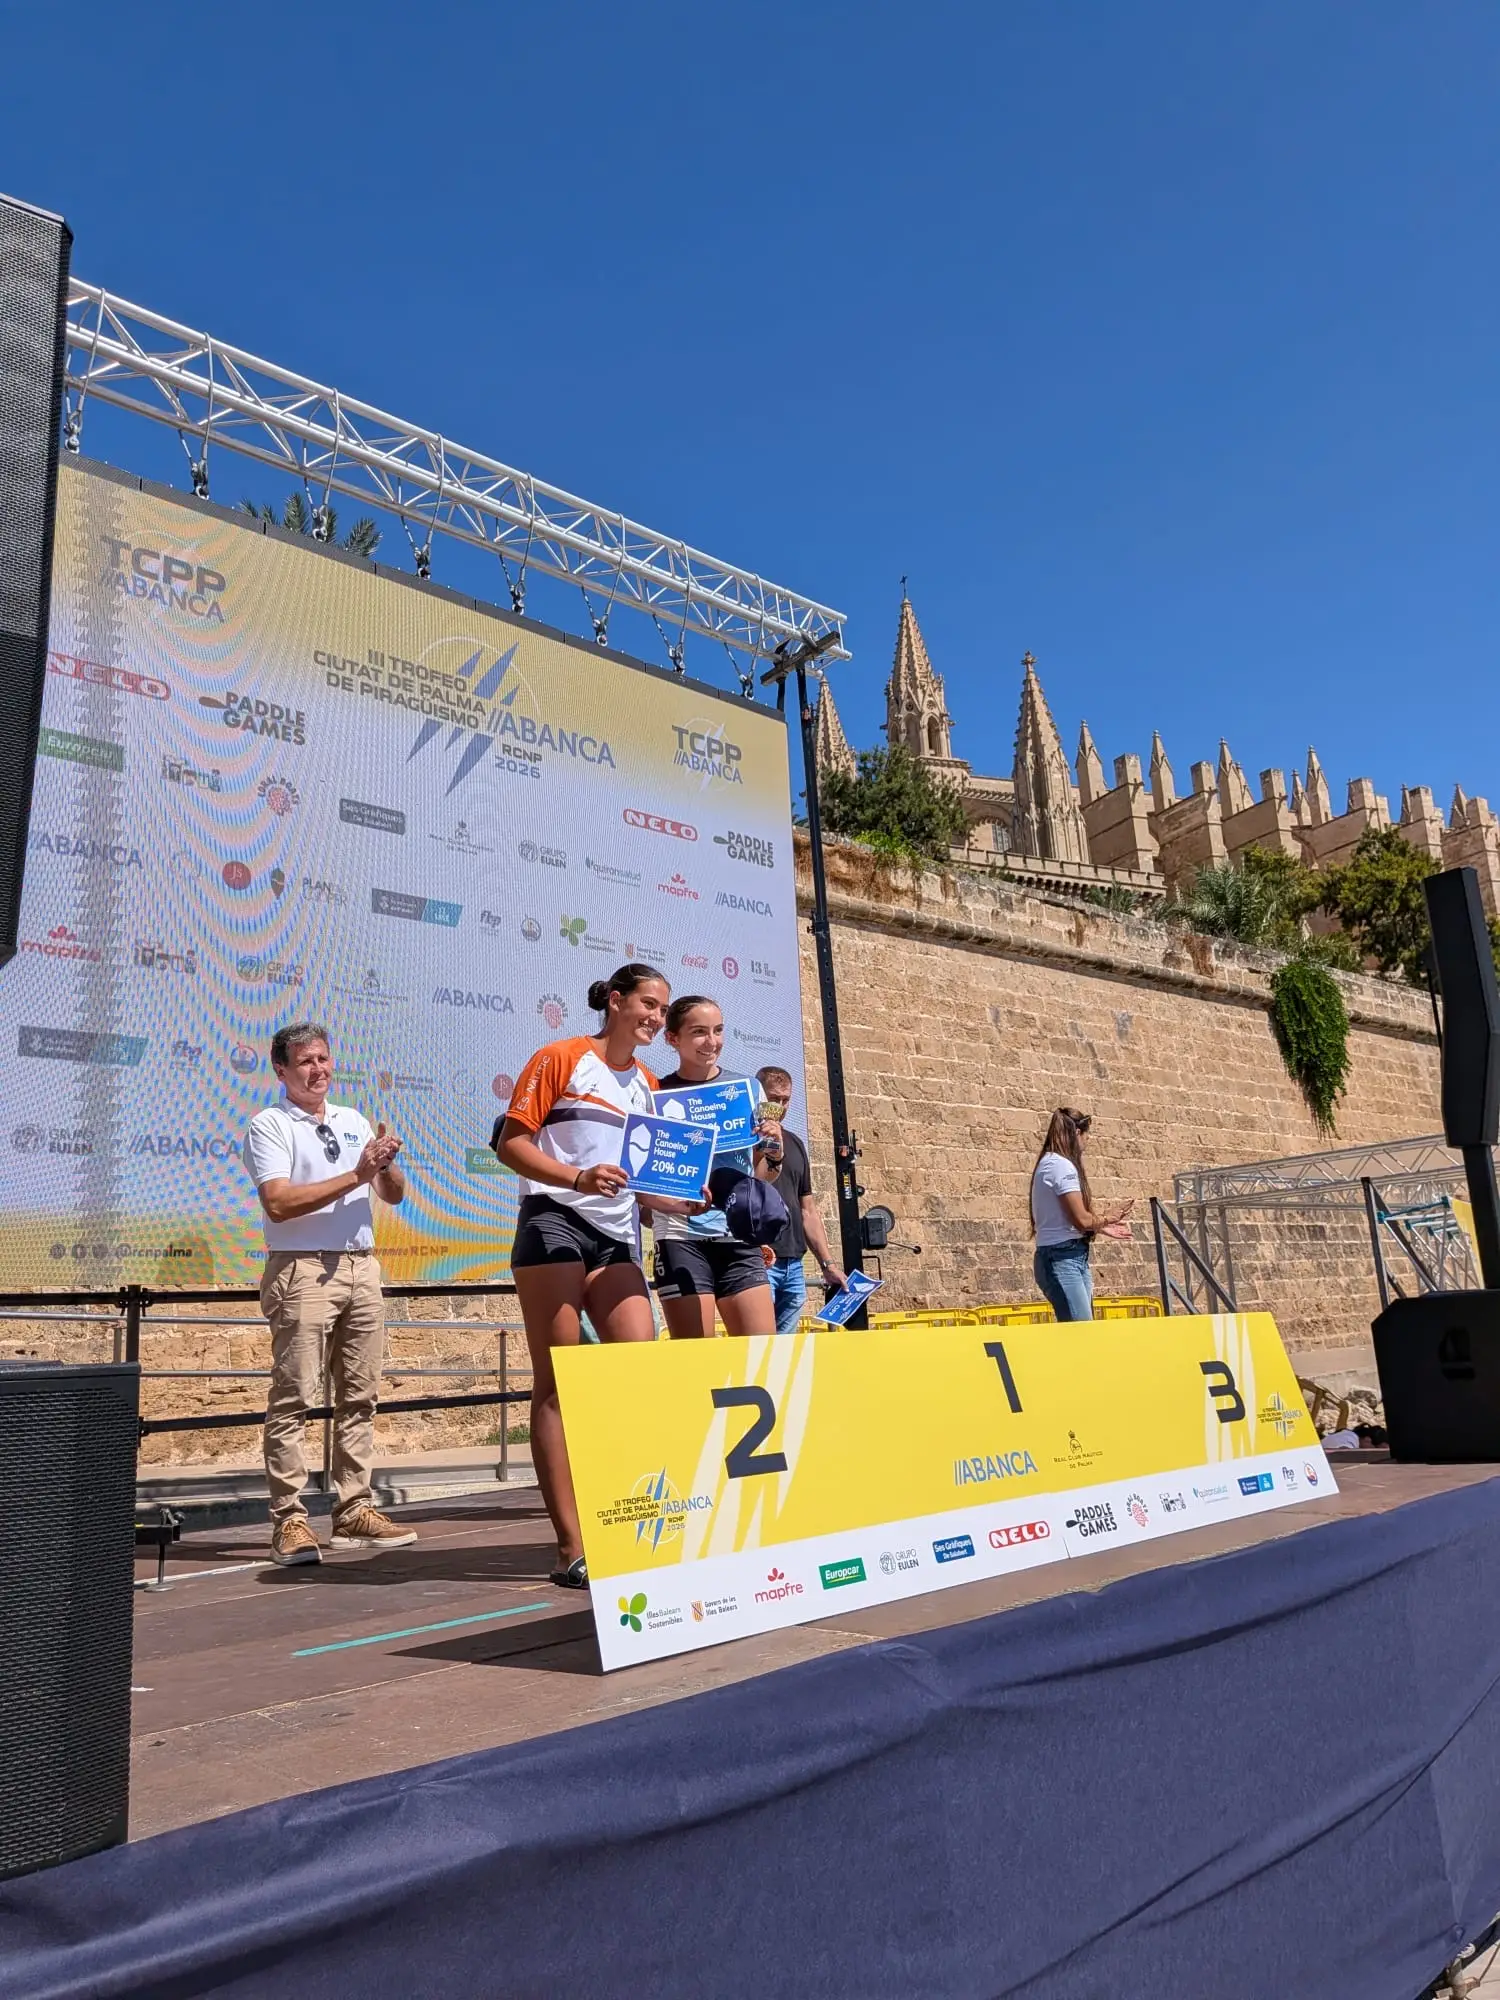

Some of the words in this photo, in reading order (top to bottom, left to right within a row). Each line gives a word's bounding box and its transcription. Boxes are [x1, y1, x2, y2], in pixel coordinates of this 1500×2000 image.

[100, 535, 226, 595] TCPP
[367, 650, 385, 667] III
[388, 656, 467, 693] TROFEO
[313, 650, 383, 682] CIUTAT
[388, 672, 416, 692] DE
[420, 683, 487, 716] PALMA
[326, 671, 354, 693] DE
[226, 691, 305, 729] PADDLE
[223, 709, 305, 746] GAMES
[502, 743, 542, 763] RCNP
[672, 725, 742, 764] TCPP
[494, 755, 541, 779] 2026
[626, 811, 696, 840] NELO
[727, 830, 774, 854] PADDLE
[540, 856, 566, 869] EULEN
[727, 845, 774, 868] GAMES
[657, 883, 699, 900] mapfre
[267, 972, 304, 987] EULEN
[517, 1097, 530, 1111] ES
[687, 1097, 703, 1106] The
[689, 1102, 727, 1114] Canoeing
[690, 1112, 717, 1121] House
[723, 1117, 746, 1131] OFF
[656, 1129, 670, 1139] The
[653, 1147, 677, 1159] House
[655, 1138, 688, 1154] Canoeing
[651, 1159, 675, 1174] 20%
[677, 1164, 699, 1178] OFF
[843, 1173, 852, 1199] FANTEK
[983, 1341, 1024, 1414] 1
[1199, 1360, 1246, 1424] 3
[711, 1385, 788, 1479] 2
[622, 1495, 652, 1506] TROFEO
[596, 1508, 622, 1519] CIUTAT
[623, 1506, 633, 1514] DE
[634, 1502, 661, 1512] PALMA
[602, 1518, 613, 1526] DE
[614, 1510, 659, 1524] PIRAGÜISMO
[667, 1515, 685, 1523] RCNP
[1074, 1502, 1113, 1521] PADDLE
[991, 1521, 1049, 1548] NELO
[1079, 1516, 1118, 1537] GAMES
[895, 1548, 917, 1561] GRUPO
[825, 1564, 860, 1581] Europcar
[898, 1558, 920, 1571] EULEN
[754, 1582, 804, 1604] mapfre
[718, 1605, 738, 1614] Balears
[648, 1615, 684, 1630] Sostenibles
